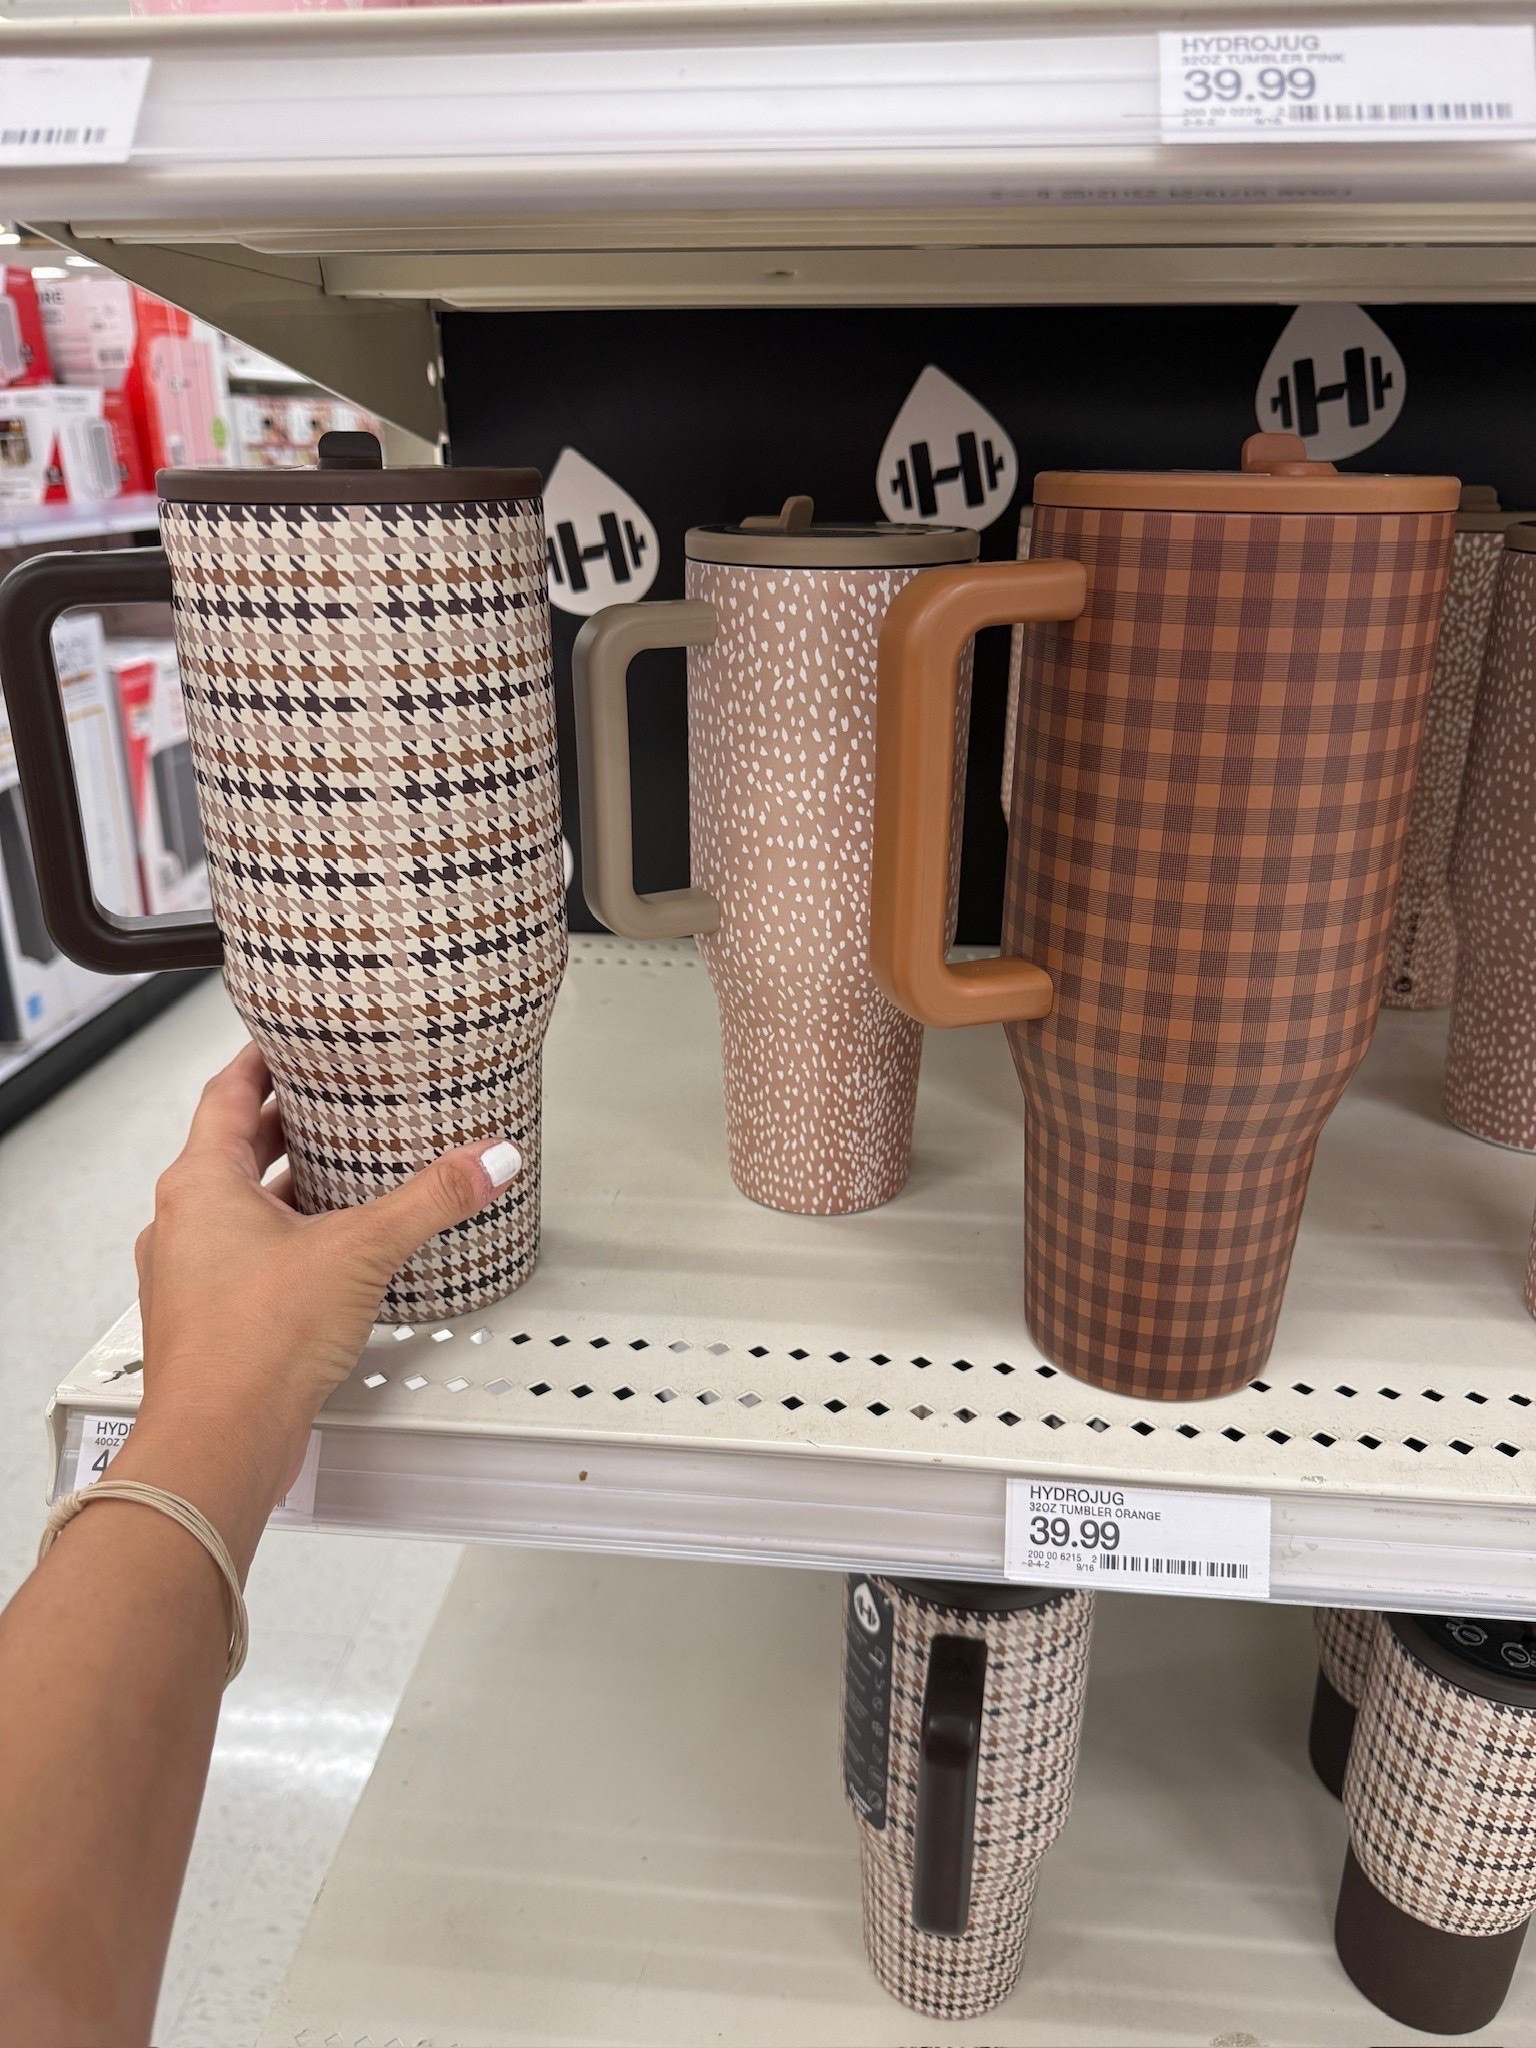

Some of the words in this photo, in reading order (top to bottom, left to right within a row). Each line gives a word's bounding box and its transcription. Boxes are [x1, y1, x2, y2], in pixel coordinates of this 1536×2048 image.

[1181, 35, 1320, 53] HYDROJUG
[1181, 55, 1220, 66] 32OZ
[1227, 54, 1303, 65] TUMBLER
[1306, 52, 1345, 64] PINK
[1183, 67, 1317, 102] 39.99
[94, 1437, 120, 1447] 40OZ
[1030, 1485, 1125, 1506] HYDROJUG
[1029, 1501, 1057, 1514] 32OZ
[1059, 1503, 1112, 1518] TUMBLER
[1114, 1508, 1162, 1521] ORANGE
[1029, 1515, 1120, 1551] 39.99
[1027, 1550, 1044, 1560] 200
[1046, 1551, 1058, 1561] 00
[1060, 1552, 1082, 1563] 6215
[1091, 1555, 1097, 1564] 2
[1076, 1562, 1095, 1573] 9/16
